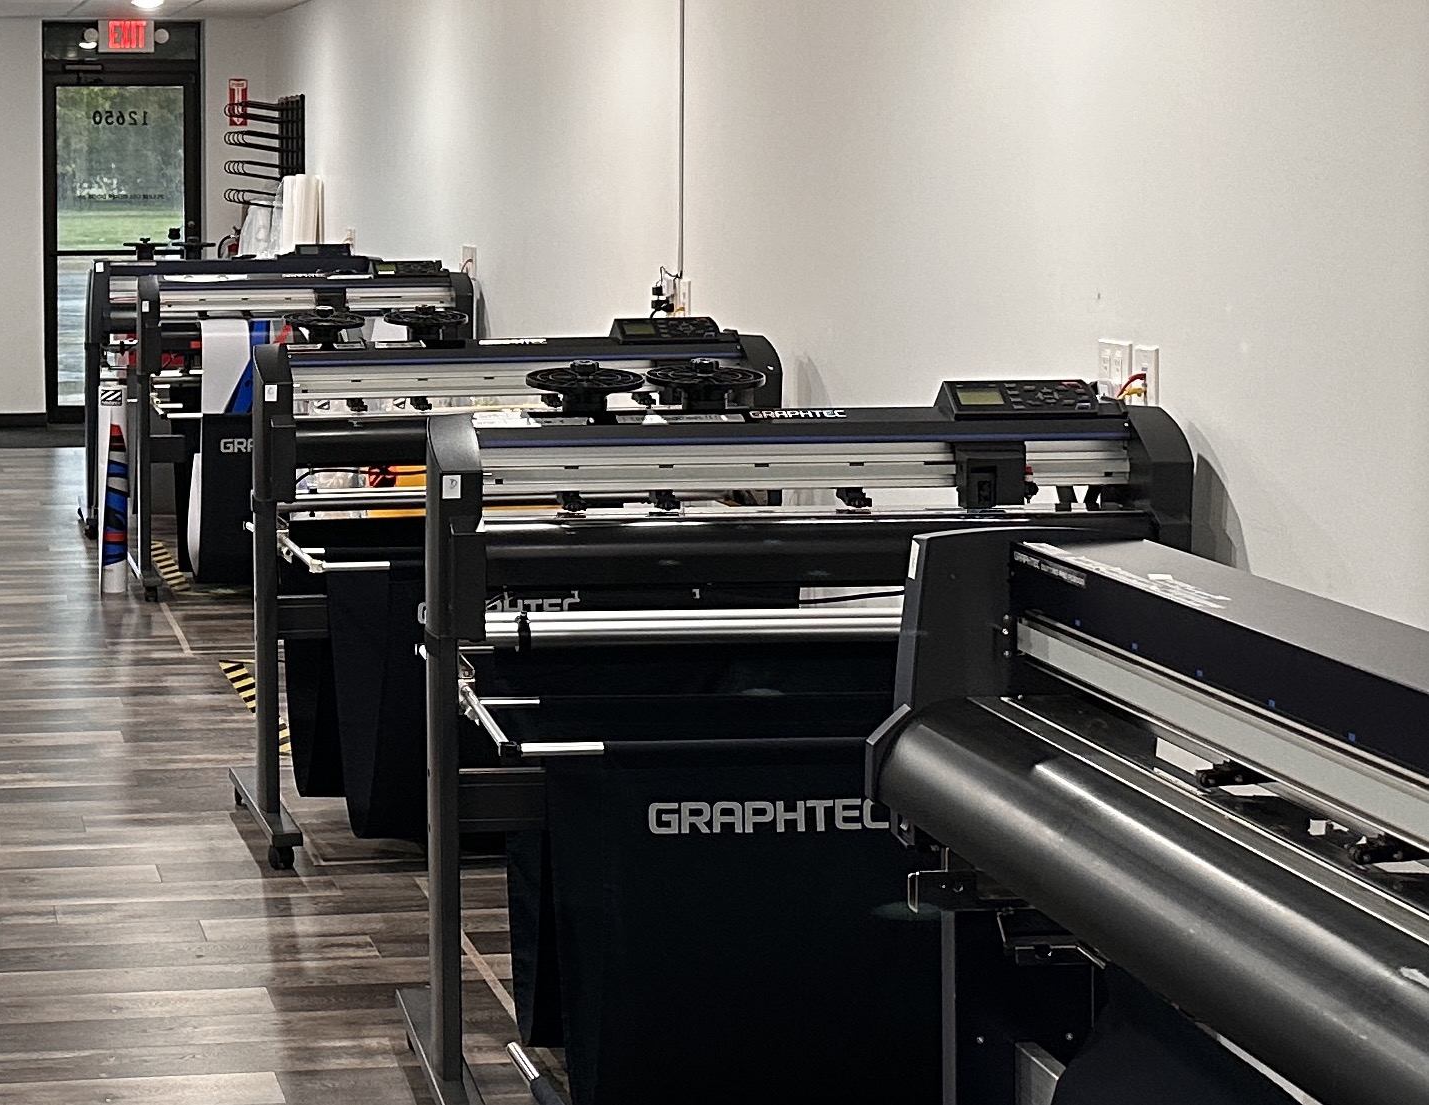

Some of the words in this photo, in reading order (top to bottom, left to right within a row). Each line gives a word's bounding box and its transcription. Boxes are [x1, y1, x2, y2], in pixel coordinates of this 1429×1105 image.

[108, 20, 147, 49] EXIT
[749, 409, 848, 419] GRAPHTEC
[647, 797, 890, 835] GRAPHTEC
